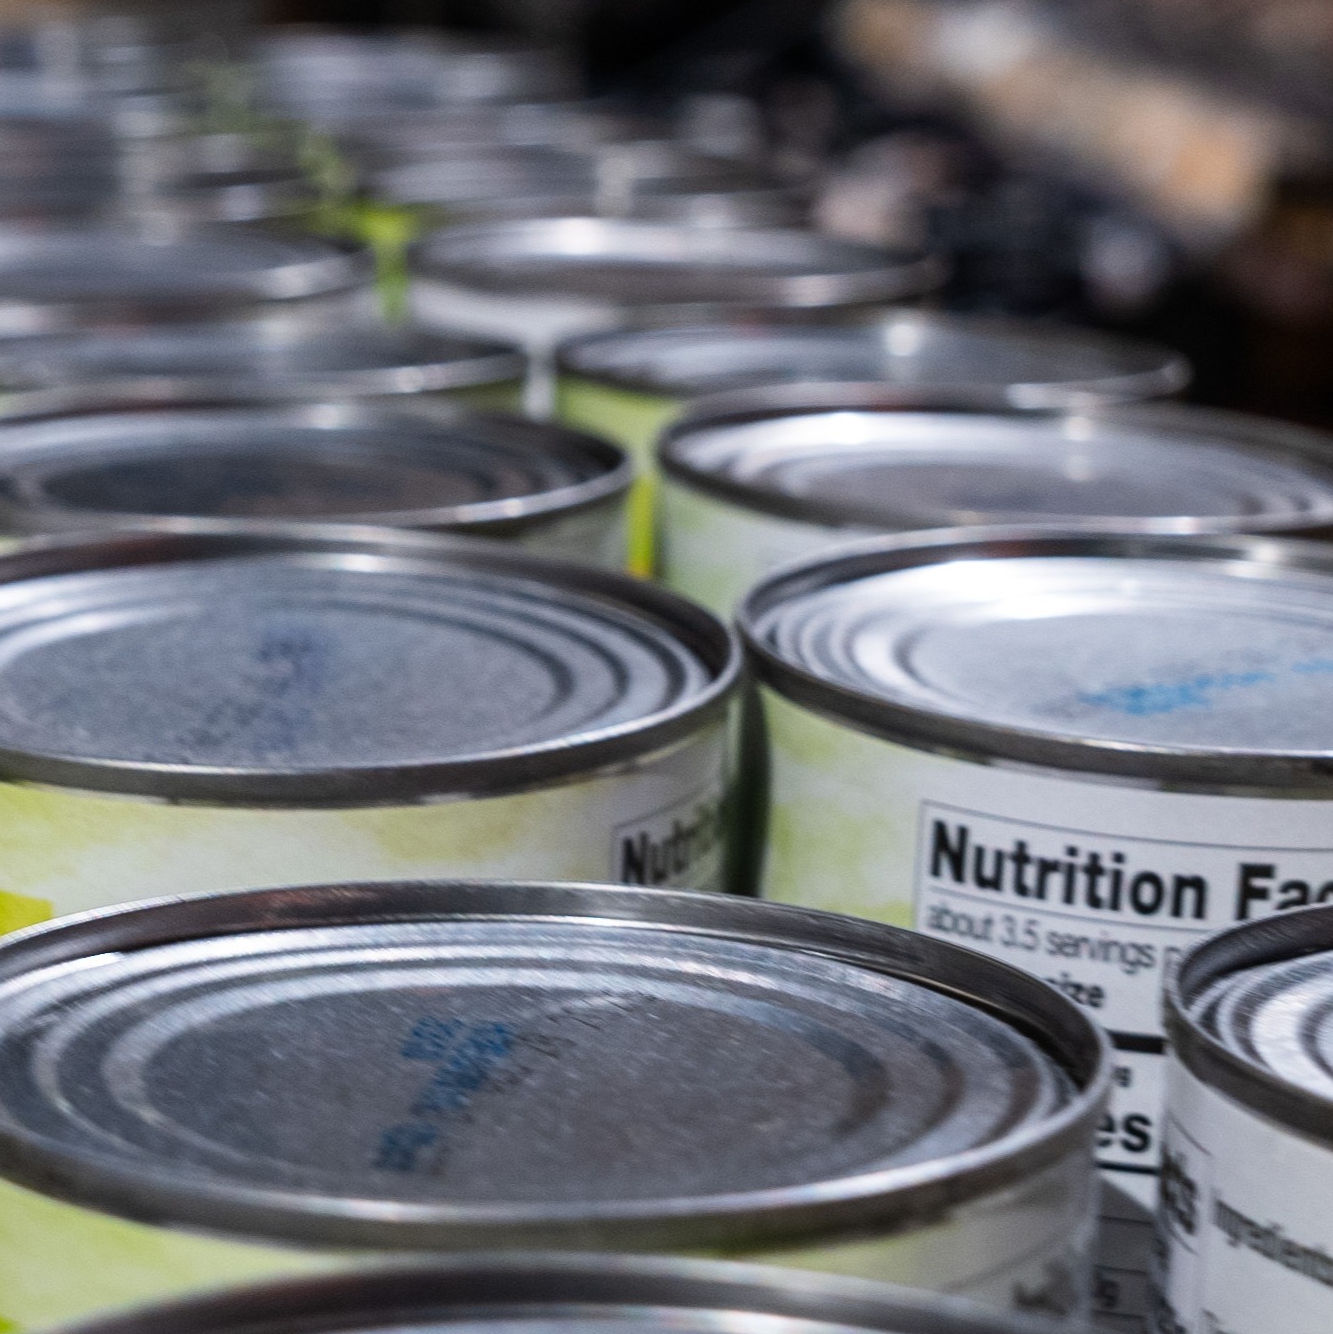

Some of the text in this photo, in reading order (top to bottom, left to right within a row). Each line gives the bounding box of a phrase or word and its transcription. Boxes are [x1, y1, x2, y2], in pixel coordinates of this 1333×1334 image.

[929, 819, 1208, 920] Nutrition
[927, 901, 994, 943] about
[999, 913, 1041, 953] 3.5
[1044, 928, 1159, 976] servings
[1043, 972, 1106, 1010] ize
